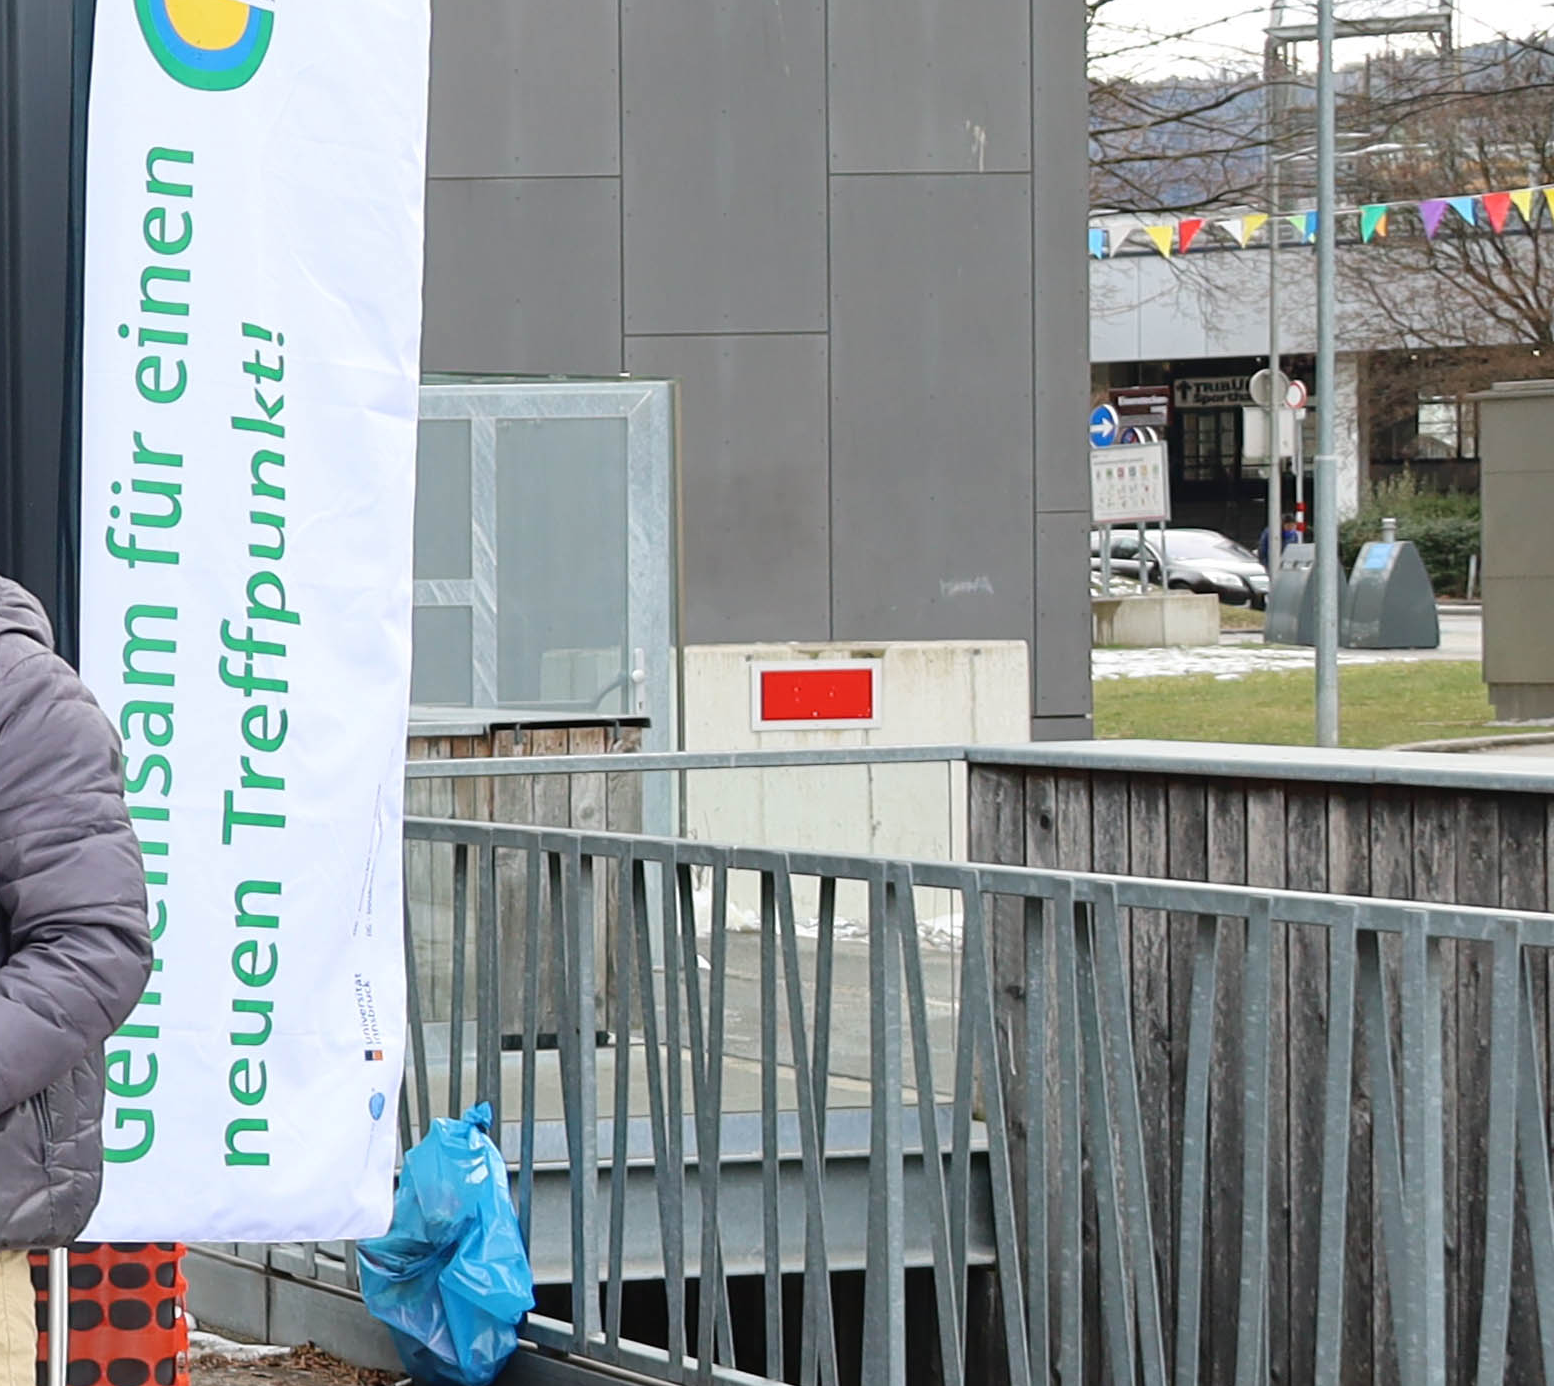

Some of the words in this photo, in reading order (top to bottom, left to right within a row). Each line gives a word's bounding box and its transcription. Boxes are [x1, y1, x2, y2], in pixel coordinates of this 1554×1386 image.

[118, 146, 194, 404] einen
[105, 431, 183, 569] für
[218, 322, 301, 845] Treffpunkt!
[224, 880, 282, 1167] neuen
